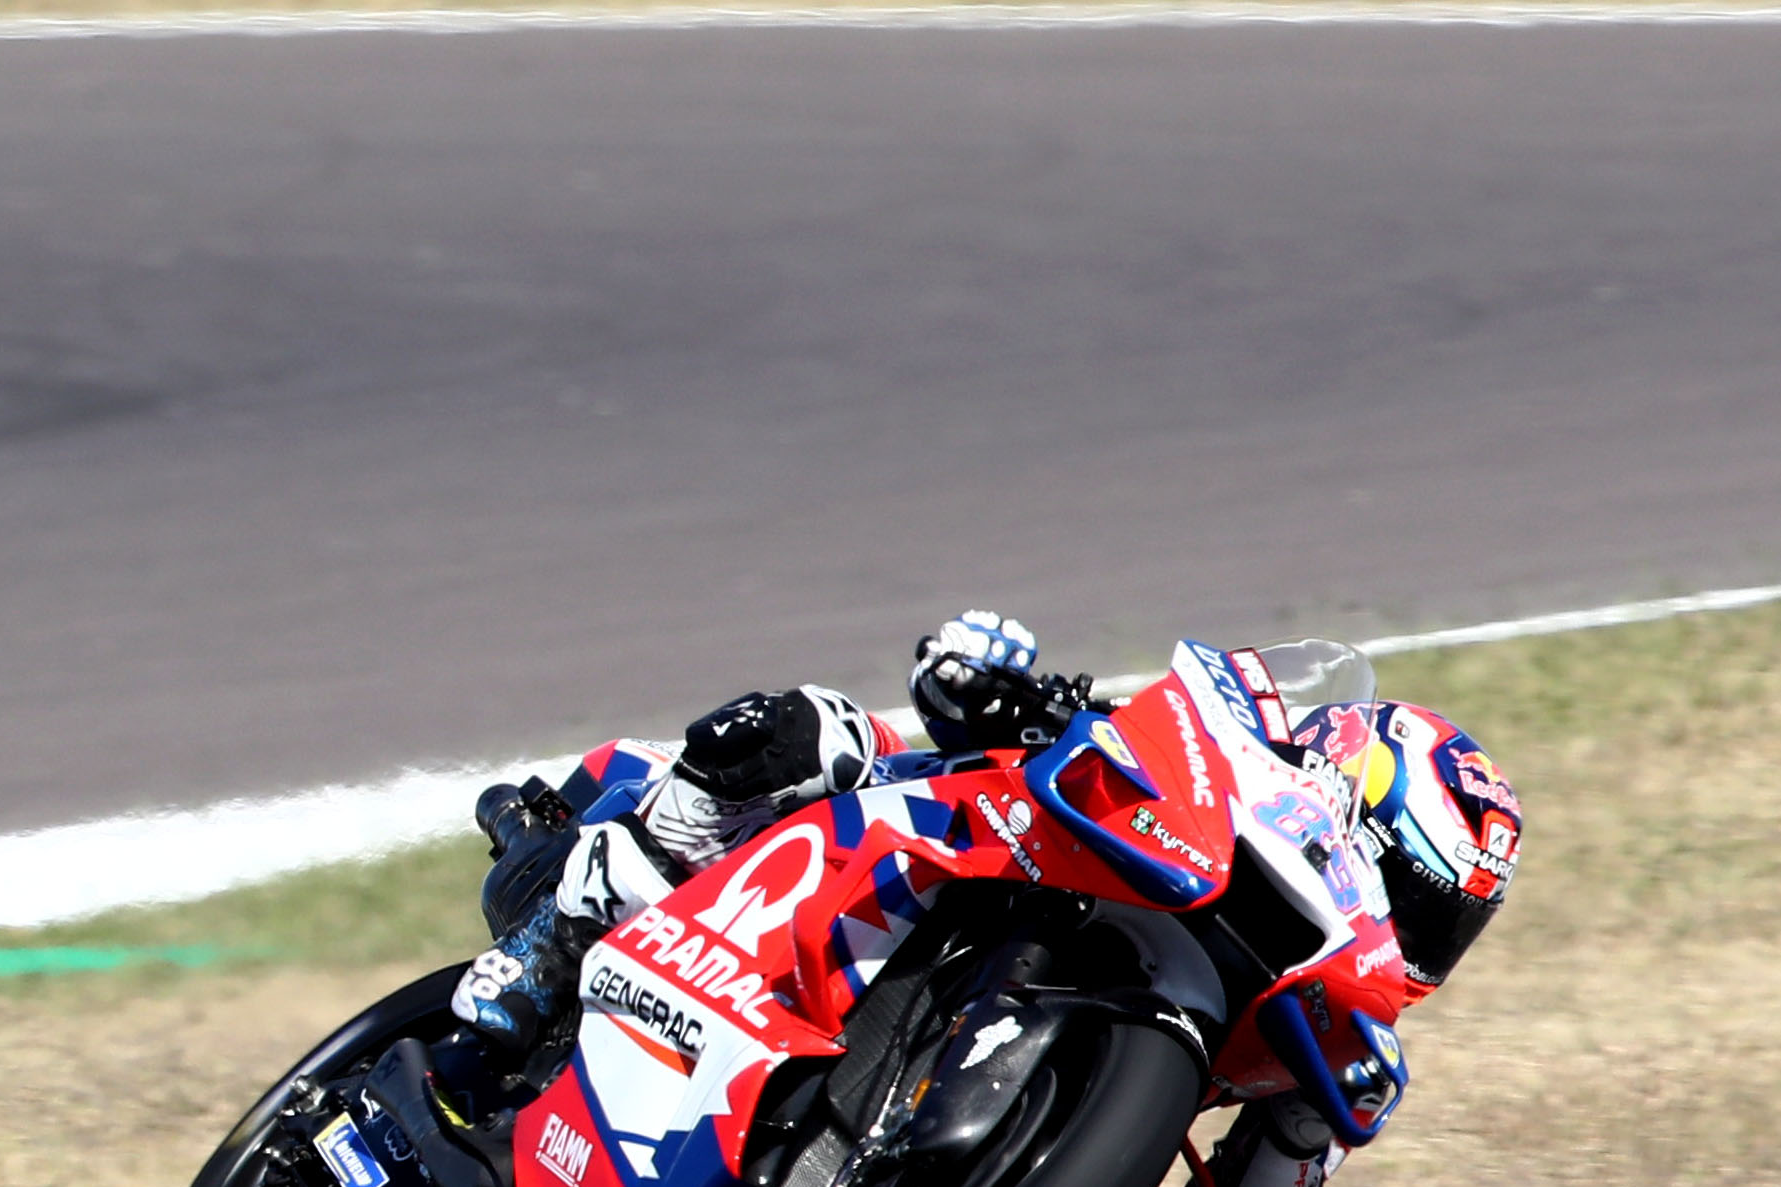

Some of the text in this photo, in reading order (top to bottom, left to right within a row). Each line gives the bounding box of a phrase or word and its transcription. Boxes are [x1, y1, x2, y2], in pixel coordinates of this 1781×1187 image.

[1176, 698, 1215, 808] PRAMAC
[1411, 861, 1454, 894] GIVES
[589, 966, 704, 1052] GENERAC
[617, 906, 776, 1030] PRAMAC
[538, 1112, 594, 1182] FIAMM
